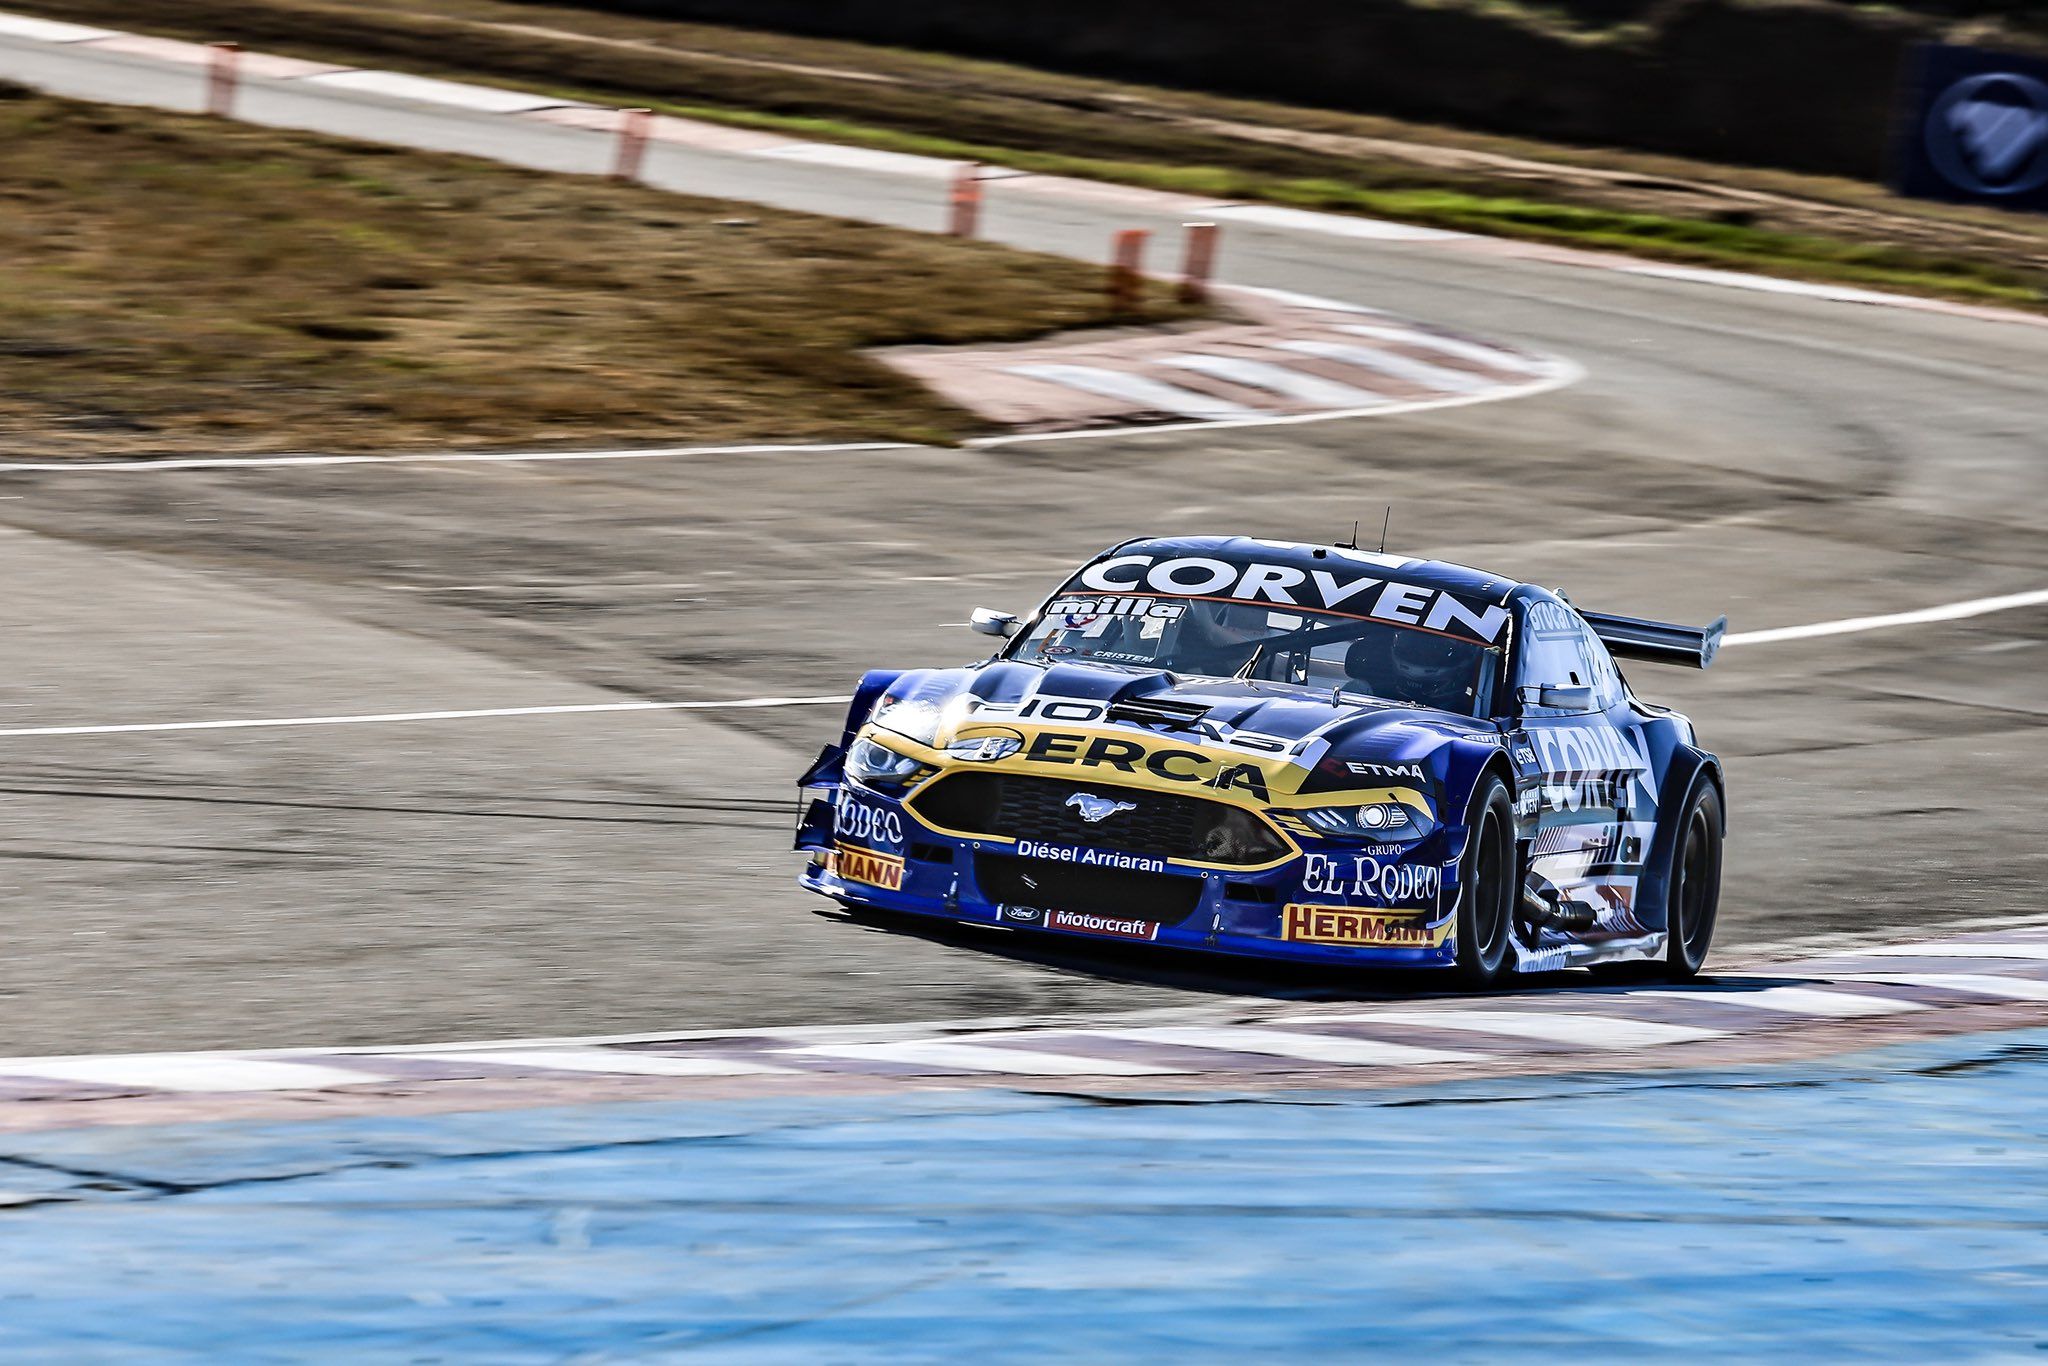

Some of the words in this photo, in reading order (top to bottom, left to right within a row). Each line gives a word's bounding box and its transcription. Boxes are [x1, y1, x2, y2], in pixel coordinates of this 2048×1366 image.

[1046, 595, 1186, 619] milla
[1081, 555, 1509, 644] CORVEN
[1345, 761, 1427, 784] ETMA
[1537, 727, 1660, 813] CORVEN
[1017, 840, 1079, 862] Diésel
[1081, 848, 1164, 873] Arriaran
[1367, 844, 1402, 856] GRUPO
[1010, 906, 1034, 919] Ford
[1056, 911, 1147, 935] Motorcraft
